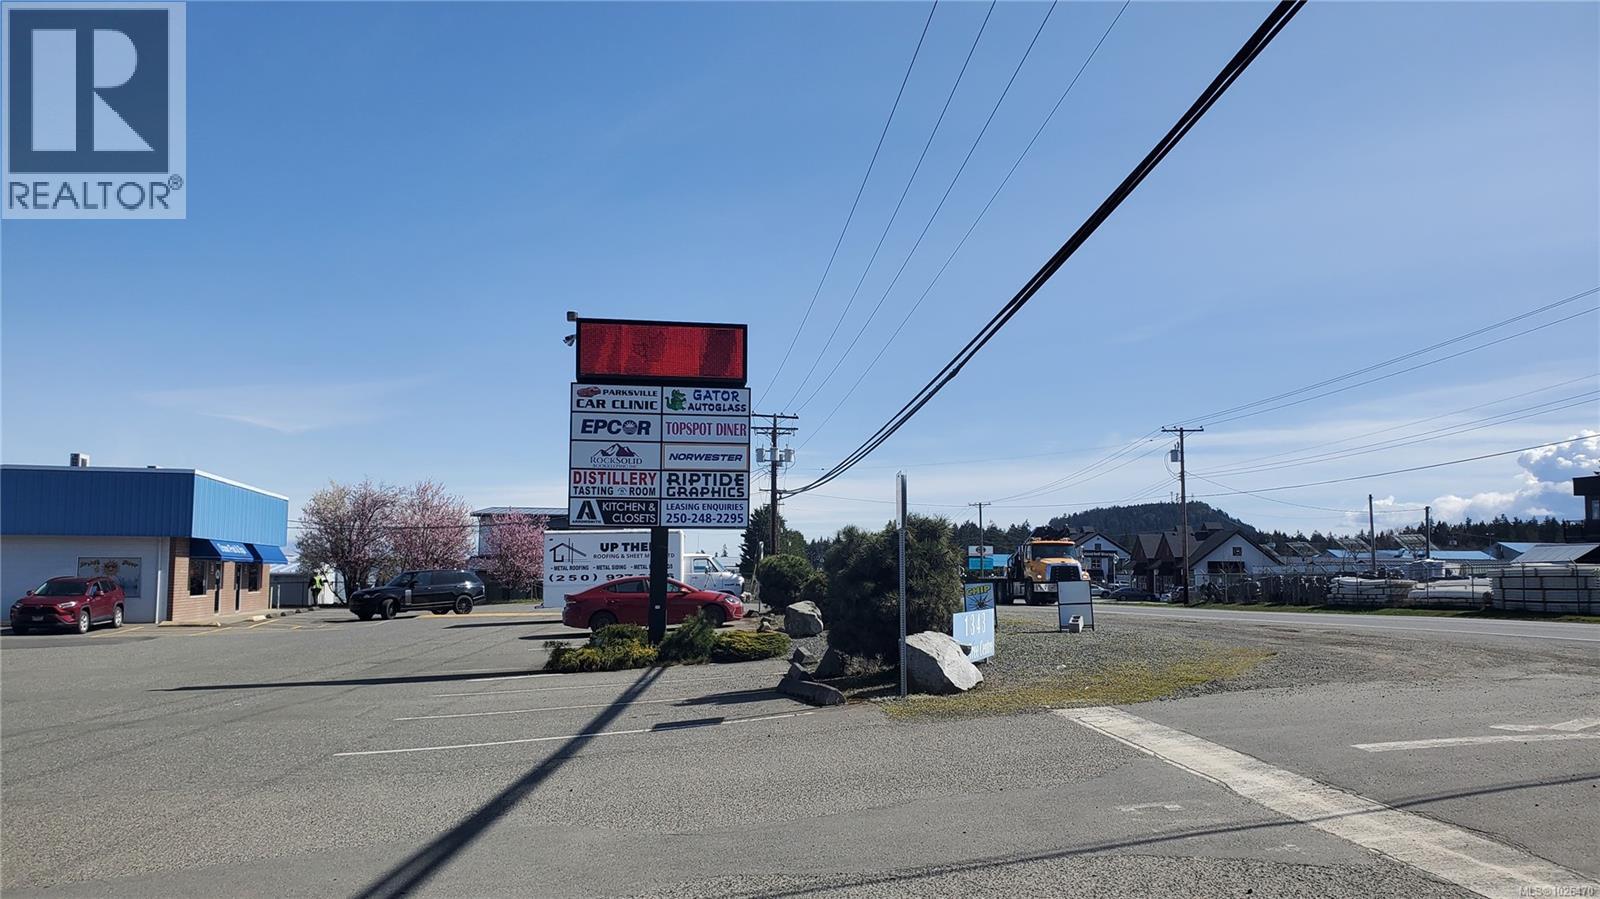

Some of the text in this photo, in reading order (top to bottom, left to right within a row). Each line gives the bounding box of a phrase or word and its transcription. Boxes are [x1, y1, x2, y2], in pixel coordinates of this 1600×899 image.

[602, 389, 658, 398] PARKSVILLE
[692, 389, 740, 402] GATOR
[576, 398, 658, 411] CAR CLINIC
[687, 403, 747, 413] AUTOGLASS
[580, 419, 652, 436] EPCOR
[665, 421, 747, 437] TOPSPOT DINER
[668, 452, 744, 462] NORWESTER
[573, 471, 657, 486] DISTILLERY
[666, 472, 745, 487] RIPTIDE
[573, 486, 656, 496] TASTING ROOM
[666, 487, 745, 498] GRAPHICS
[602, 502, 656, 512] KITCHEN &
[666, 503, 744, 511] LEASING ENQUIRIES
[612, 513, 656, 523] CLOSETS
[666, 513, 744, 524] 250-248-2295
[600, 542, 652, 552] UP THE
[549, 573, 597, 583] (250)
[966, 585, 991, 596] CHIP
